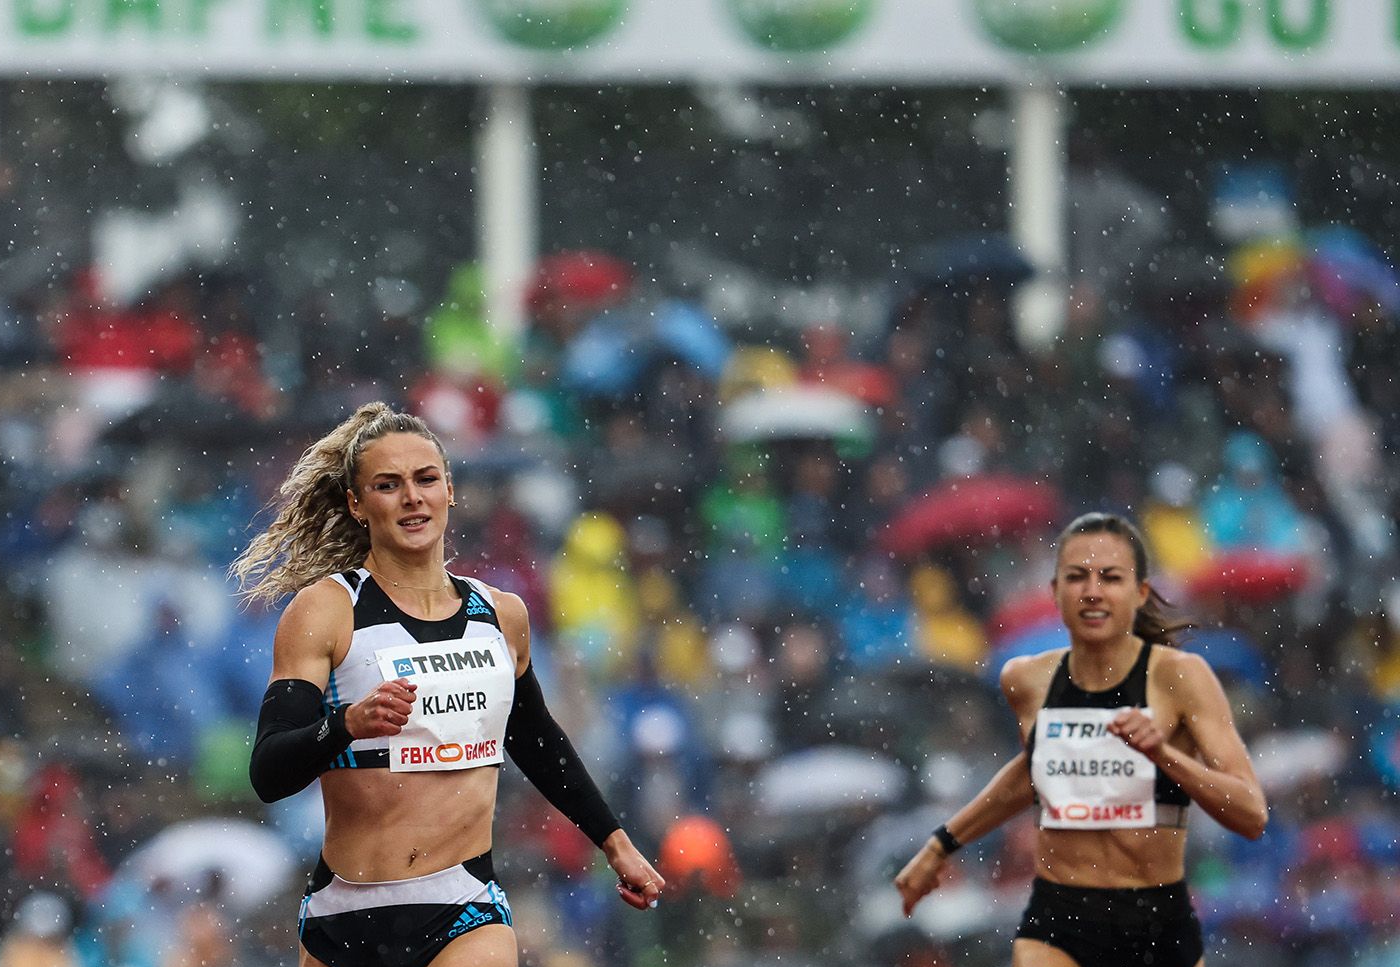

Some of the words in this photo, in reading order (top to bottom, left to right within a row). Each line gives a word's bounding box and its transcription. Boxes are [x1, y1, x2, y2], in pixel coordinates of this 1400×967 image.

[412, 649, 496, 674] TRIMM
[422, 691, 487, 715] KLAVER
[401, 746, 435, 764] FBK
[465, 740, 497, 761] GAMES
[1046, 760, 1135, 777] SAALBERG
[1092, 805, 1145, 821] GAMES
